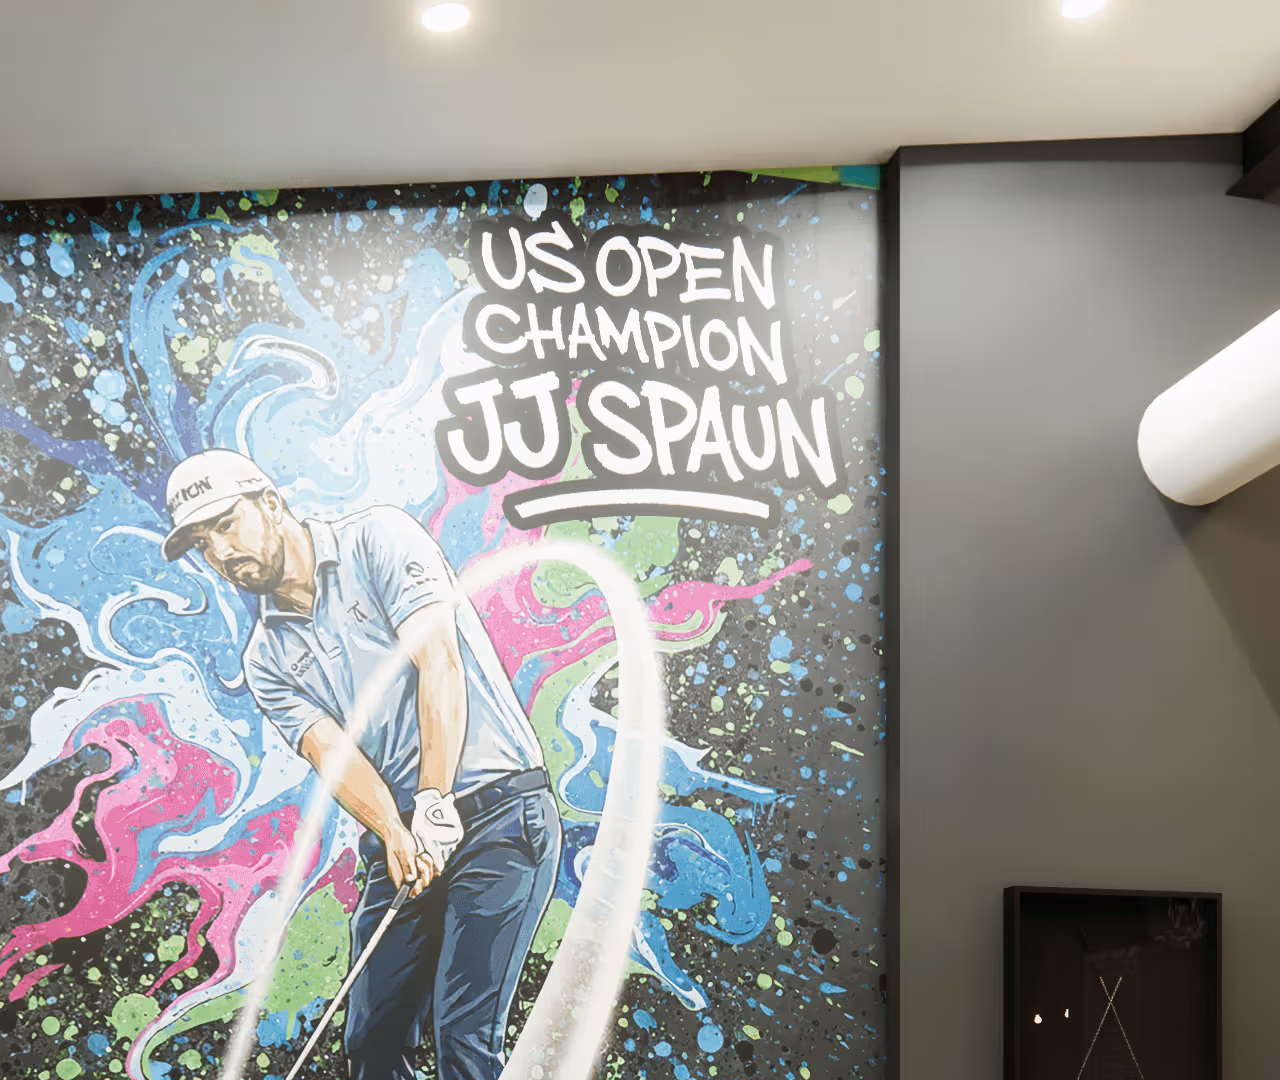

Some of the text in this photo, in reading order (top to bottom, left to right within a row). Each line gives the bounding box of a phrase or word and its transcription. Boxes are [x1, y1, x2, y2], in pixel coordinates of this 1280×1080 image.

[480, 220, 777, 310] US OPEN
[474, 302, 789, 386] CHAMPION
[447, 371, 838, 489] JJ SPAUN
